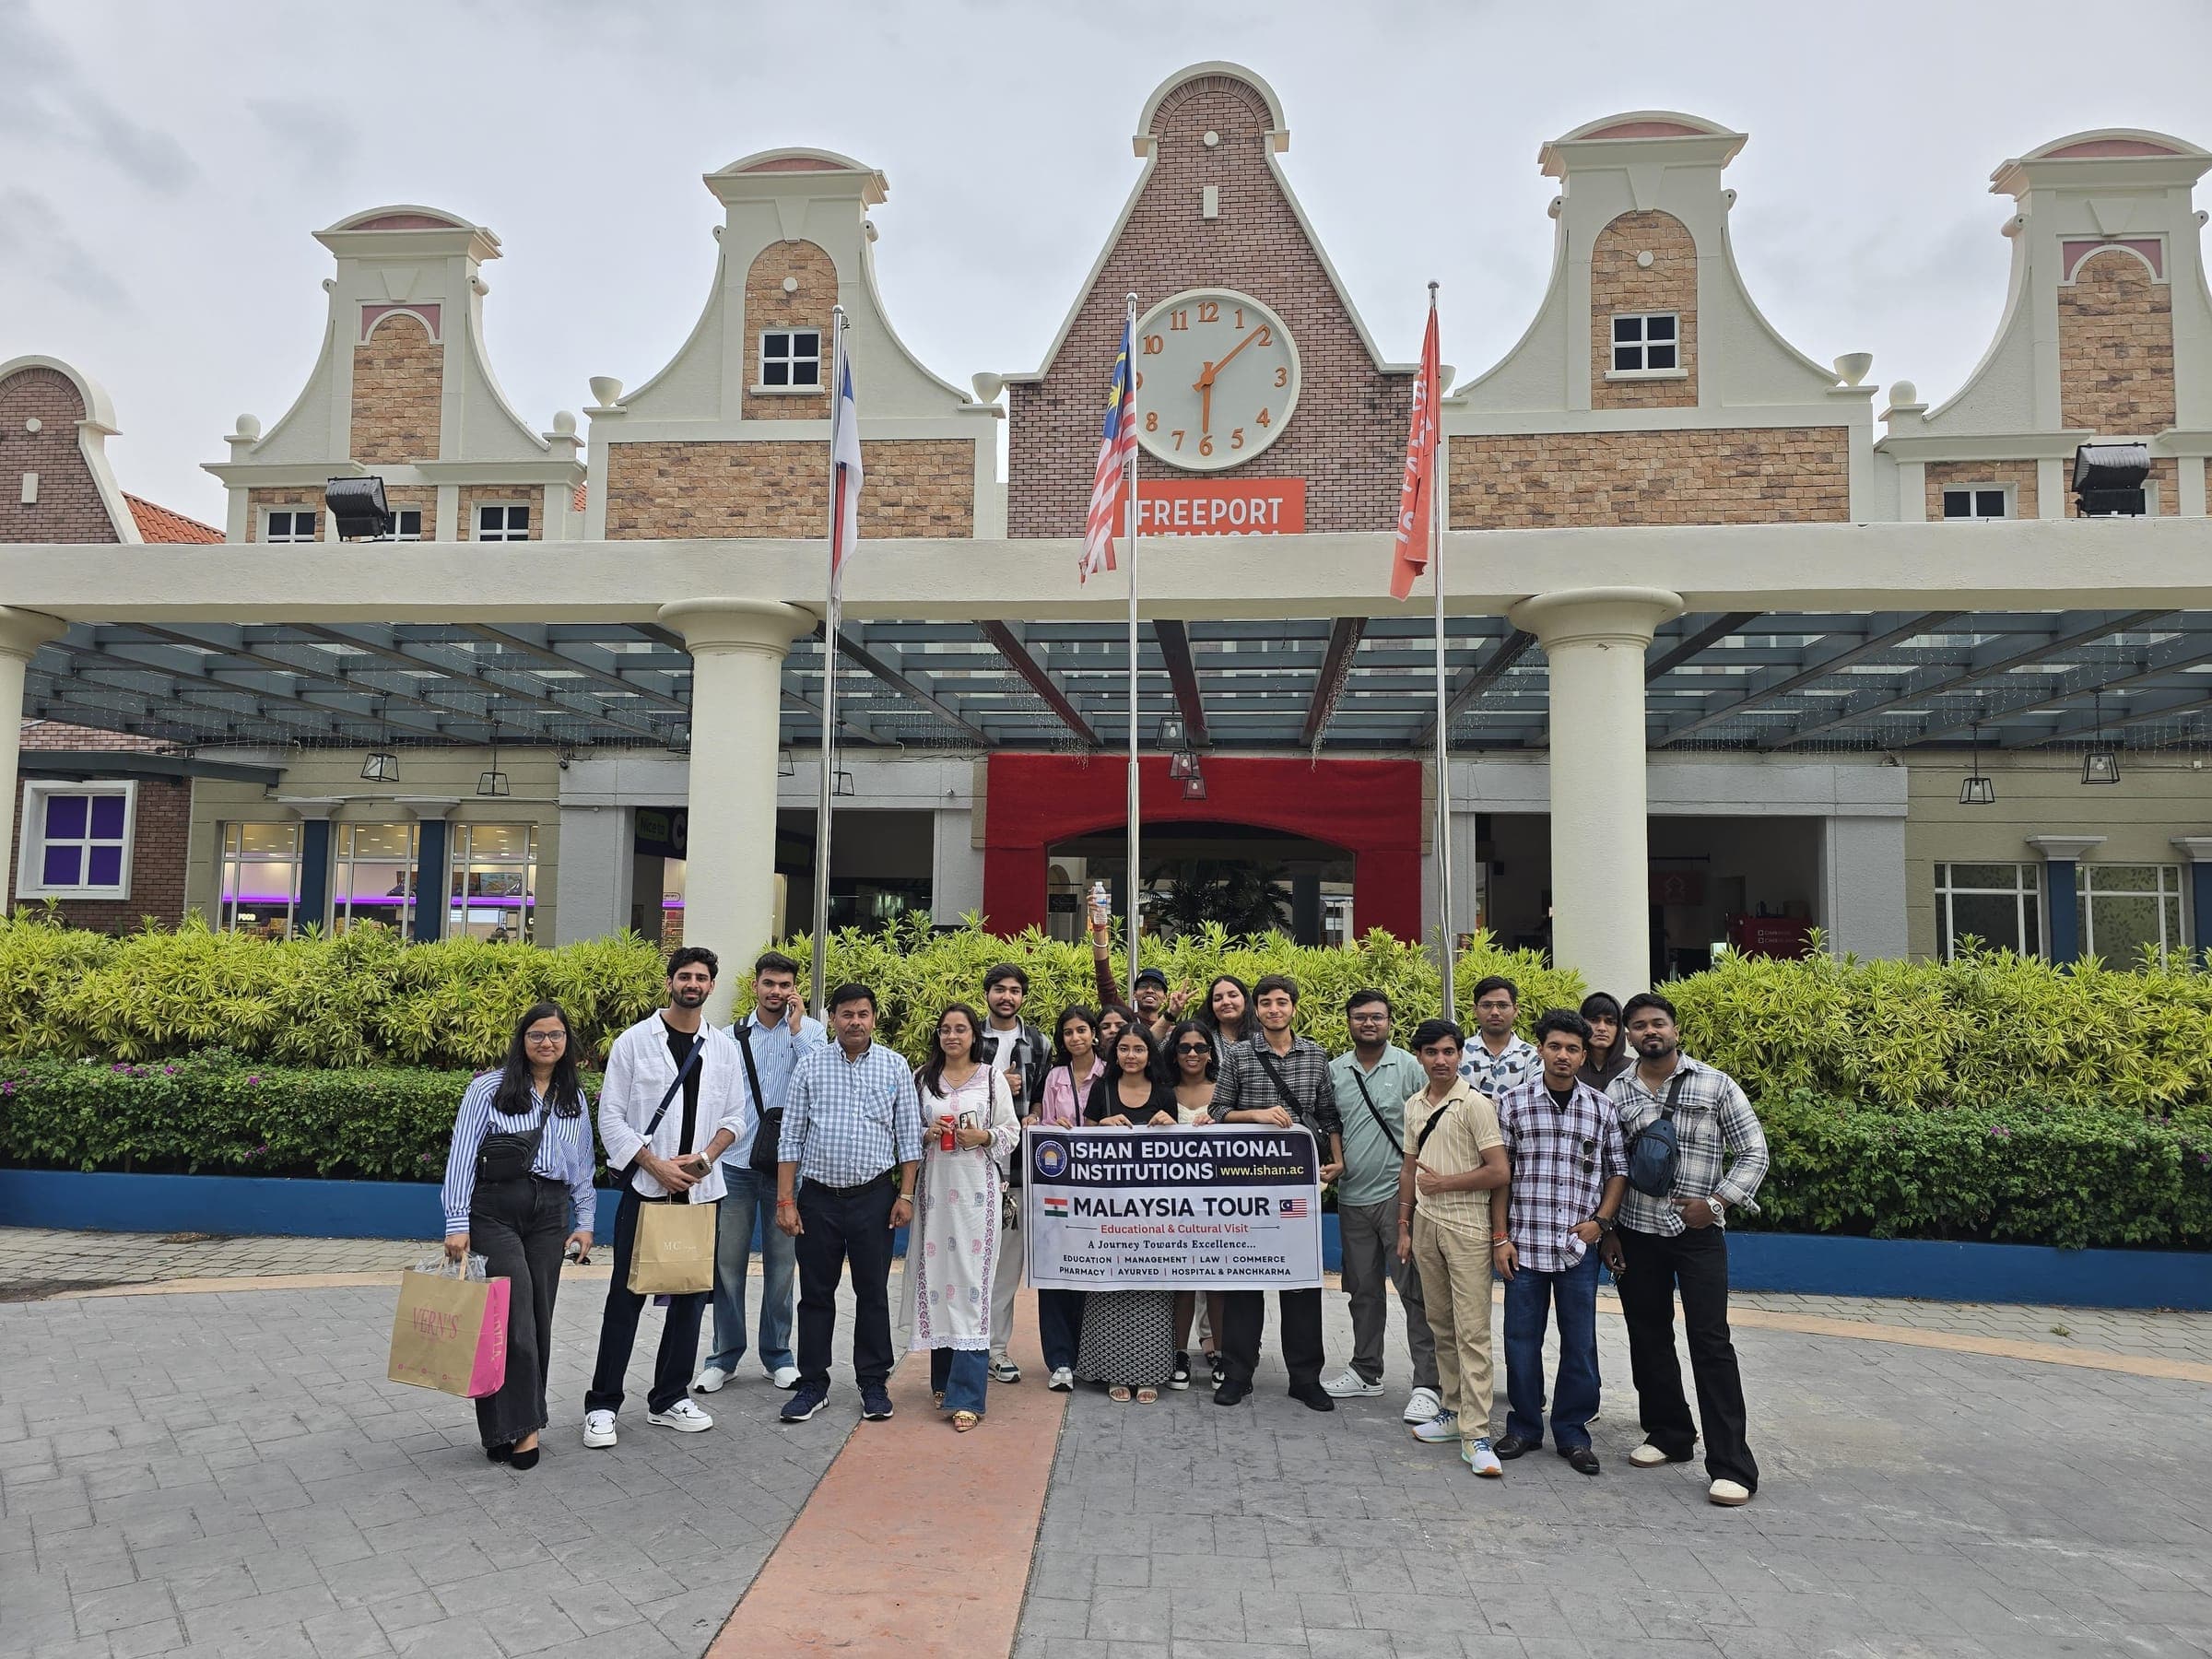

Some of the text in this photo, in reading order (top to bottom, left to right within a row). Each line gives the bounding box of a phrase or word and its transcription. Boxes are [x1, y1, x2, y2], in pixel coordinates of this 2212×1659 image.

[1171, 310, 1189, 331] 11
[1198, 301, 1218, 323] 12
[1235, 309, 1244, 329] 1
[1143, 335, 1164, 355] 10
[1258, 327, 1273, 347] 2
[1274, 368, 1288, 388] 3
[1146, 412, 1159, 432] 8
[1256, 407, 1271, 428] 4
[1171, 429, 1185, 451] 7
[1199, 435, 1213, 456] 6
[1231, 428, 1244, 449] 5
[1136, 498, 1284, 526] FREEPORT
[1070, 1142, 1133, 1159] ISHAN
[1141, 1140, 1293, 1159] EDUCATIONAL
[1071, 1162, 1214, 1181] INSTITUTIONS
[1220, 1164, 1304, 1176] www.ishan.ac
[1074, 1196, 1270, 1218] MALAYSIA TOUR
[1100, 1223, 1249, 1234] Educational & Cultural Visit
[1088, 1240, 1095, 1249] A
[1098, 1241, 1140, 1252] Journey
[1143, 1240, 1189, 1249] Towards
[1063, 1254, 1112, 1264] EDUCATION
[1059, 1266, 1106, 1277] PHARMACY
[1227, 1267, 1291, 1276] PANCHKARMA
[412, 1307, 459, 1339] VERN'S
